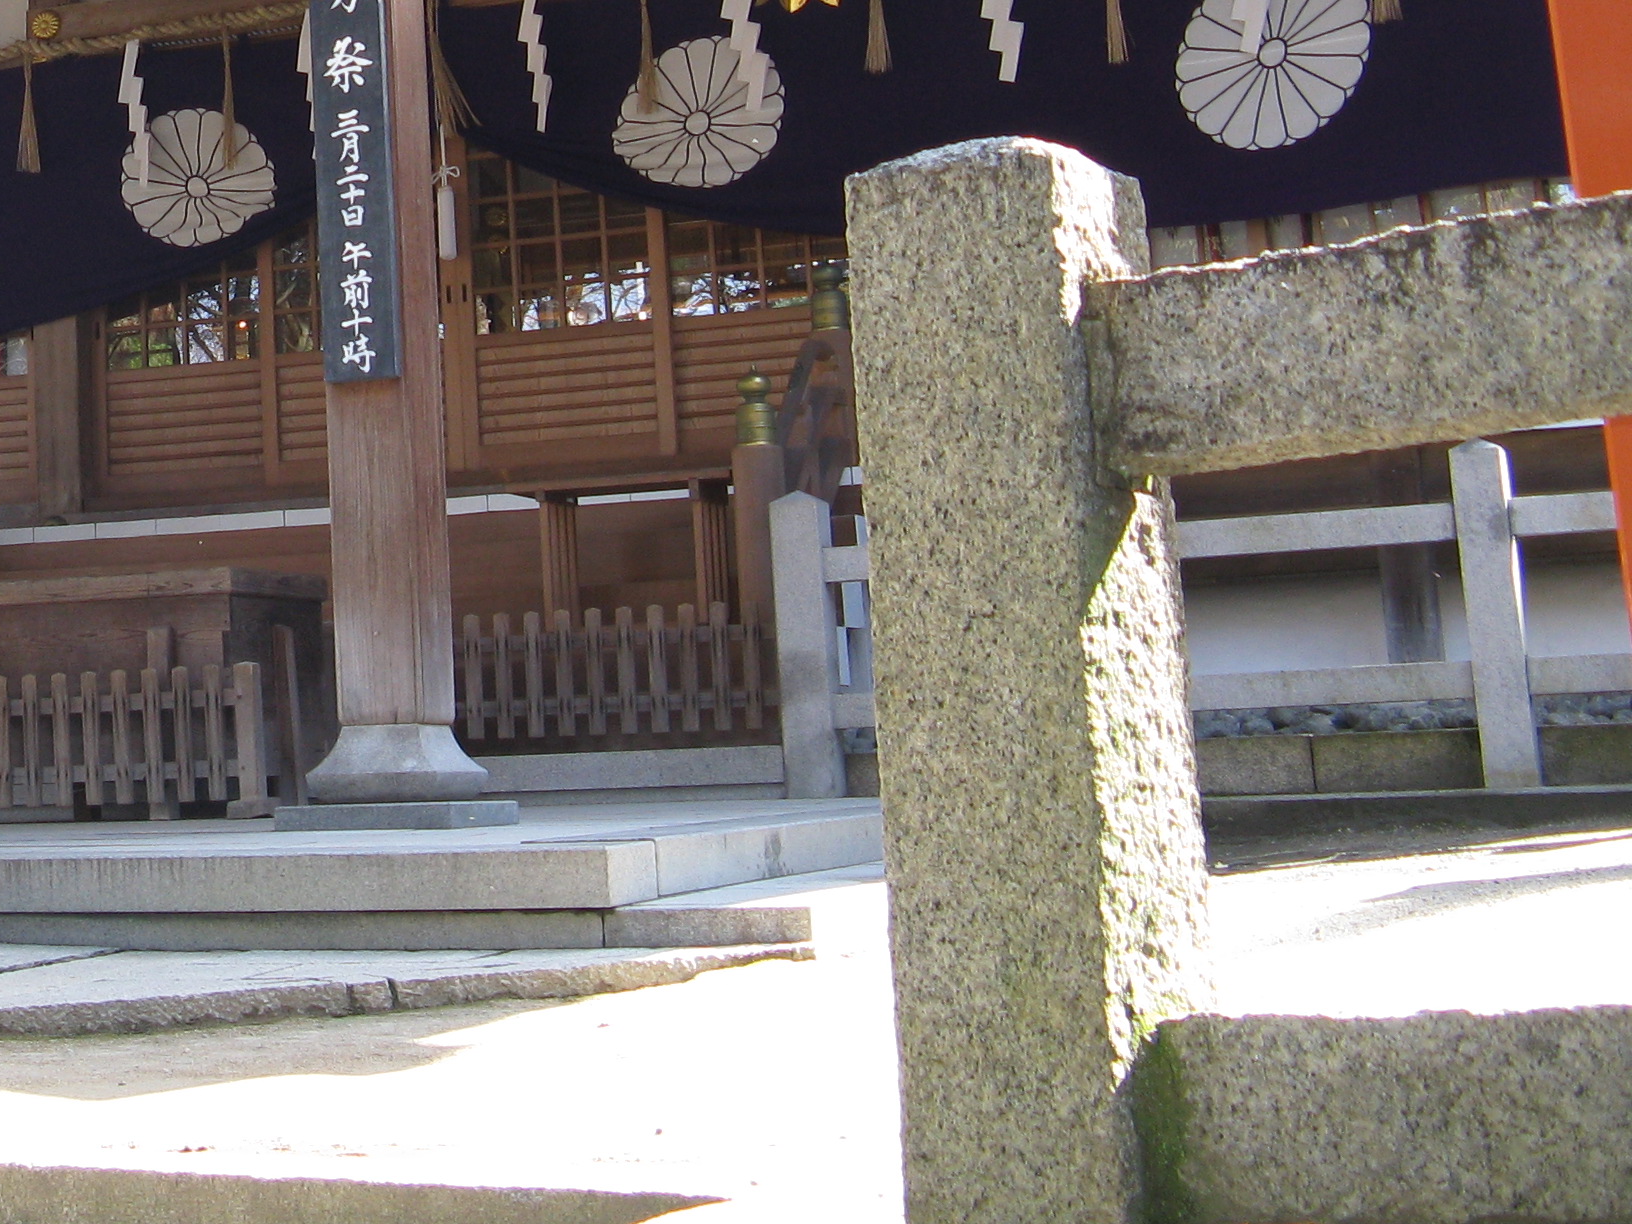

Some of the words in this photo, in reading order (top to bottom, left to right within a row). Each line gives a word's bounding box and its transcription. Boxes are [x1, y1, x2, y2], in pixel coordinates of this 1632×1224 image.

[330, 108, 370, 227] 三月二十日
[340, 240, 377, 374] 午前十時
